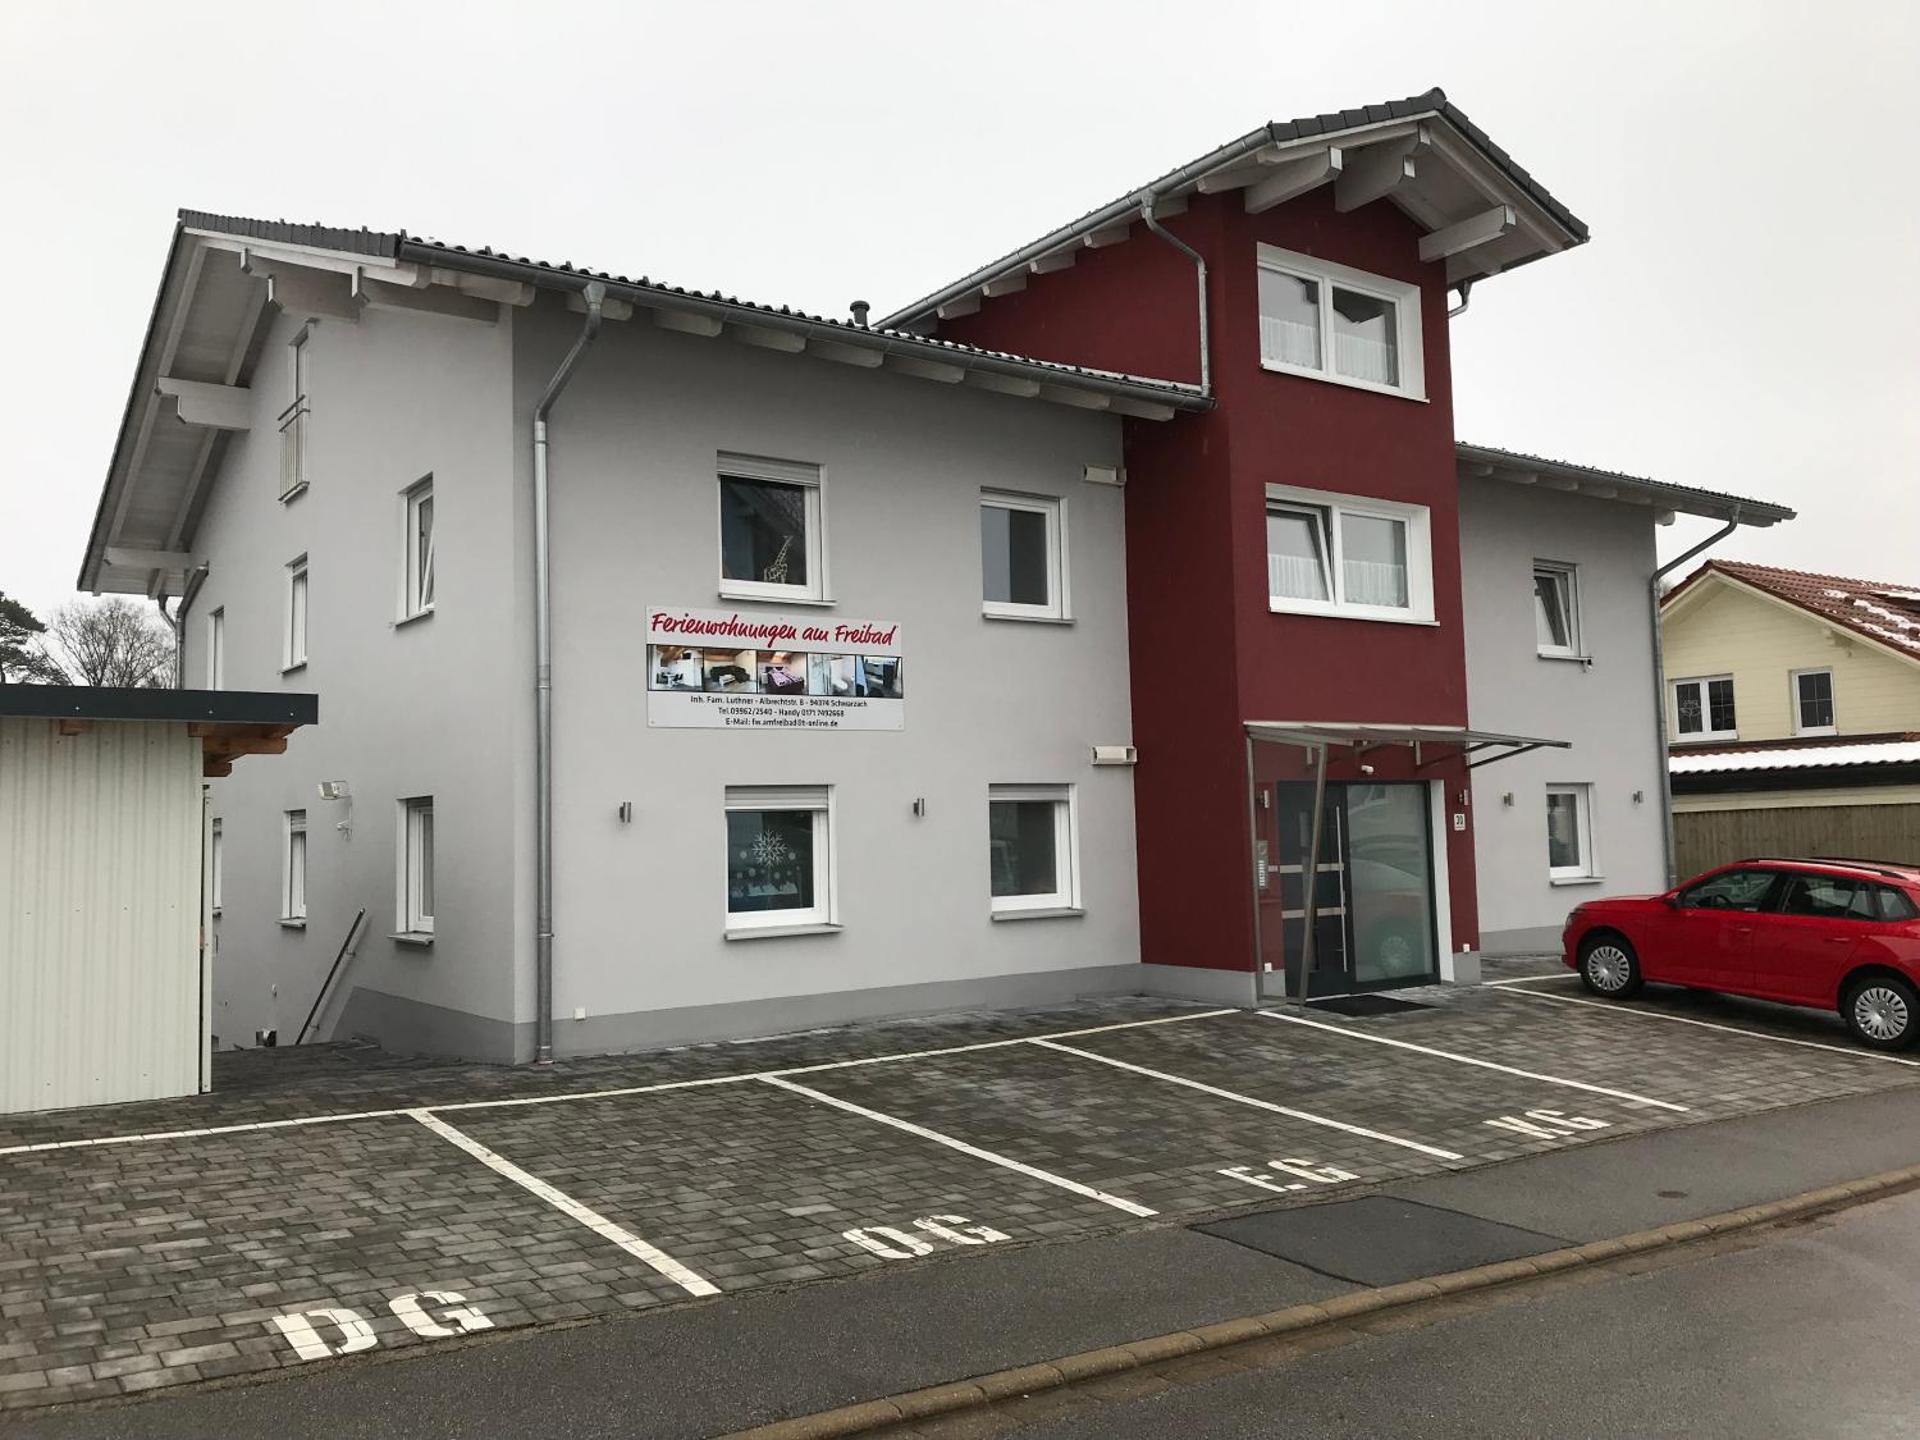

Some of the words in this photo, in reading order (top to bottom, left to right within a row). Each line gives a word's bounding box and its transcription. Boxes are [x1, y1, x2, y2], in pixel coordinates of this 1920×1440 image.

[652, 613, 797, 648] Ferienwohnungen
[802, 626, 829, 641] am
[835, 625, 896, 646] Freibad
[707, 696, 725, 704] Fam.
[779, 708, 800, 717] Handy
[725, 717, 751, 726] E-Mail:
[1216, 1158, 1361, 1193] EG
[842, 1214, 1013, 1259] OG
[271, 1290, 496, 1361] DG
